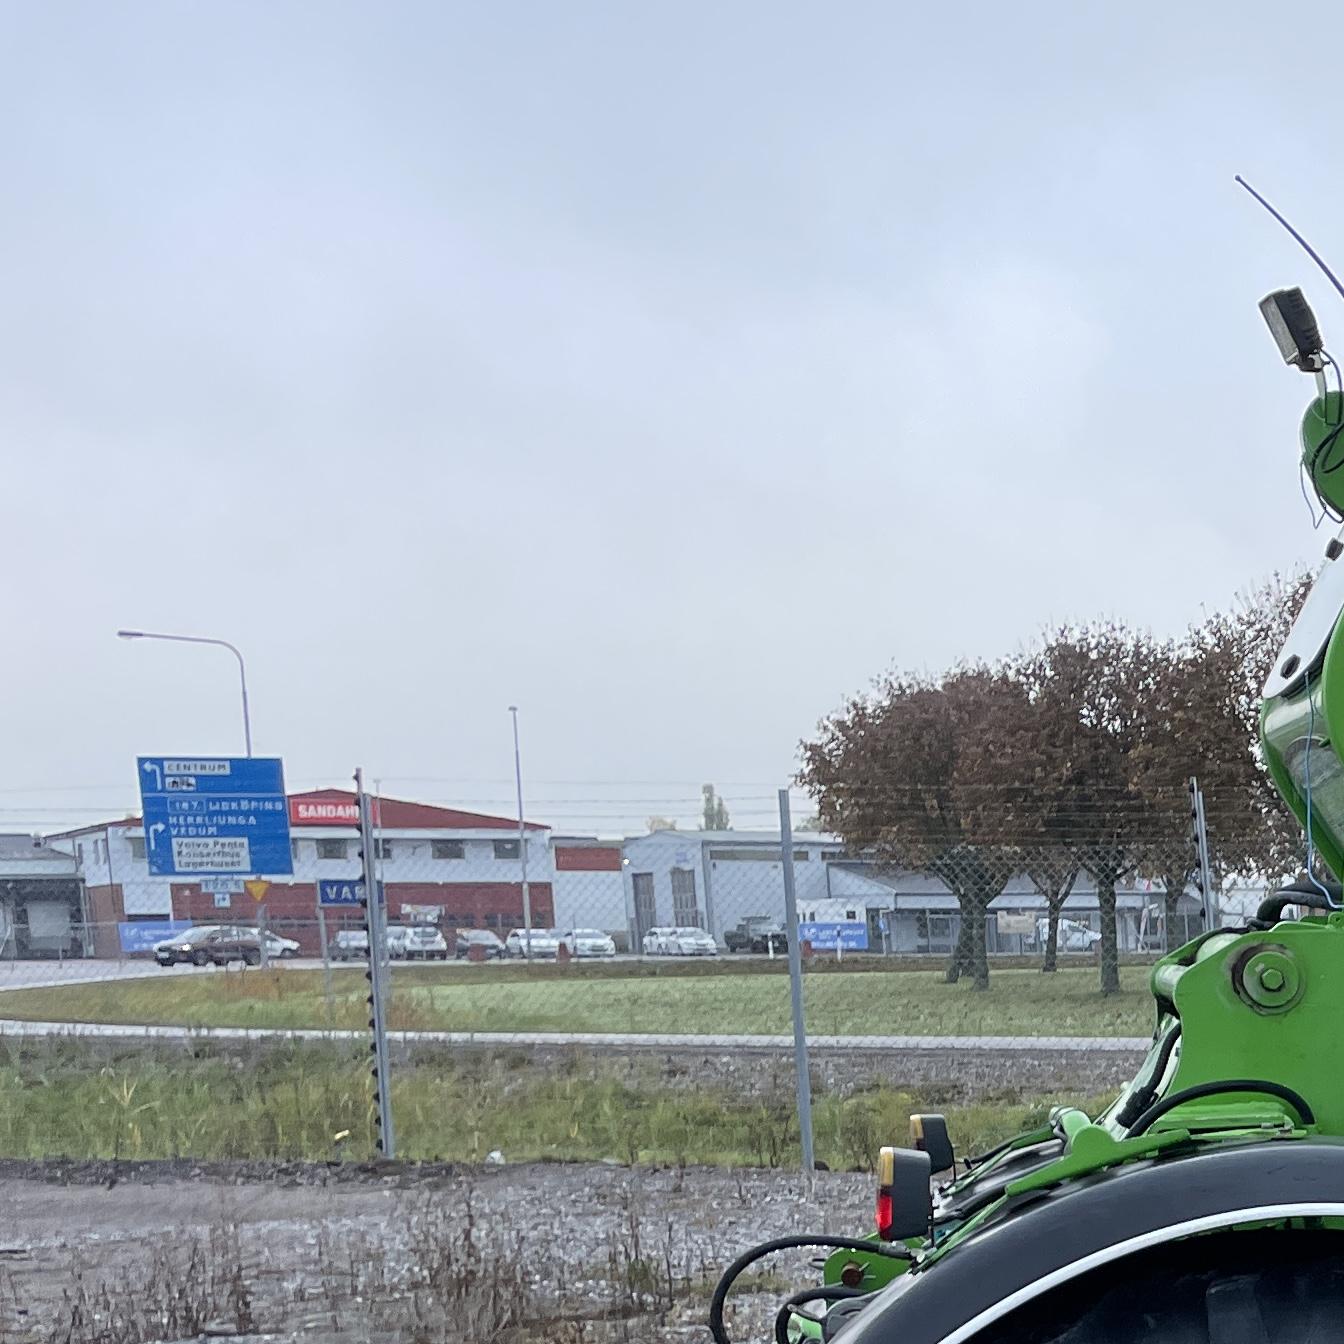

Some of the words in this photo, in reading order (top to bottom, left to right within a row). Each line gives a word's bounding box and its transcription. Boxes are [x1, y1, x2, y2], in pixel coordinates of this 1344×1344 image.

[167, 761, 226, 772] CENTRUM
[208, 799, 283, 811] LIDKÖPING
[168, 815, 257, 825] HERRLJUNGA
[169, 826, 217, 835] VEDUM
[176, 840, 209, 849] Volvo
[213, 840, 245, 849] Penta
